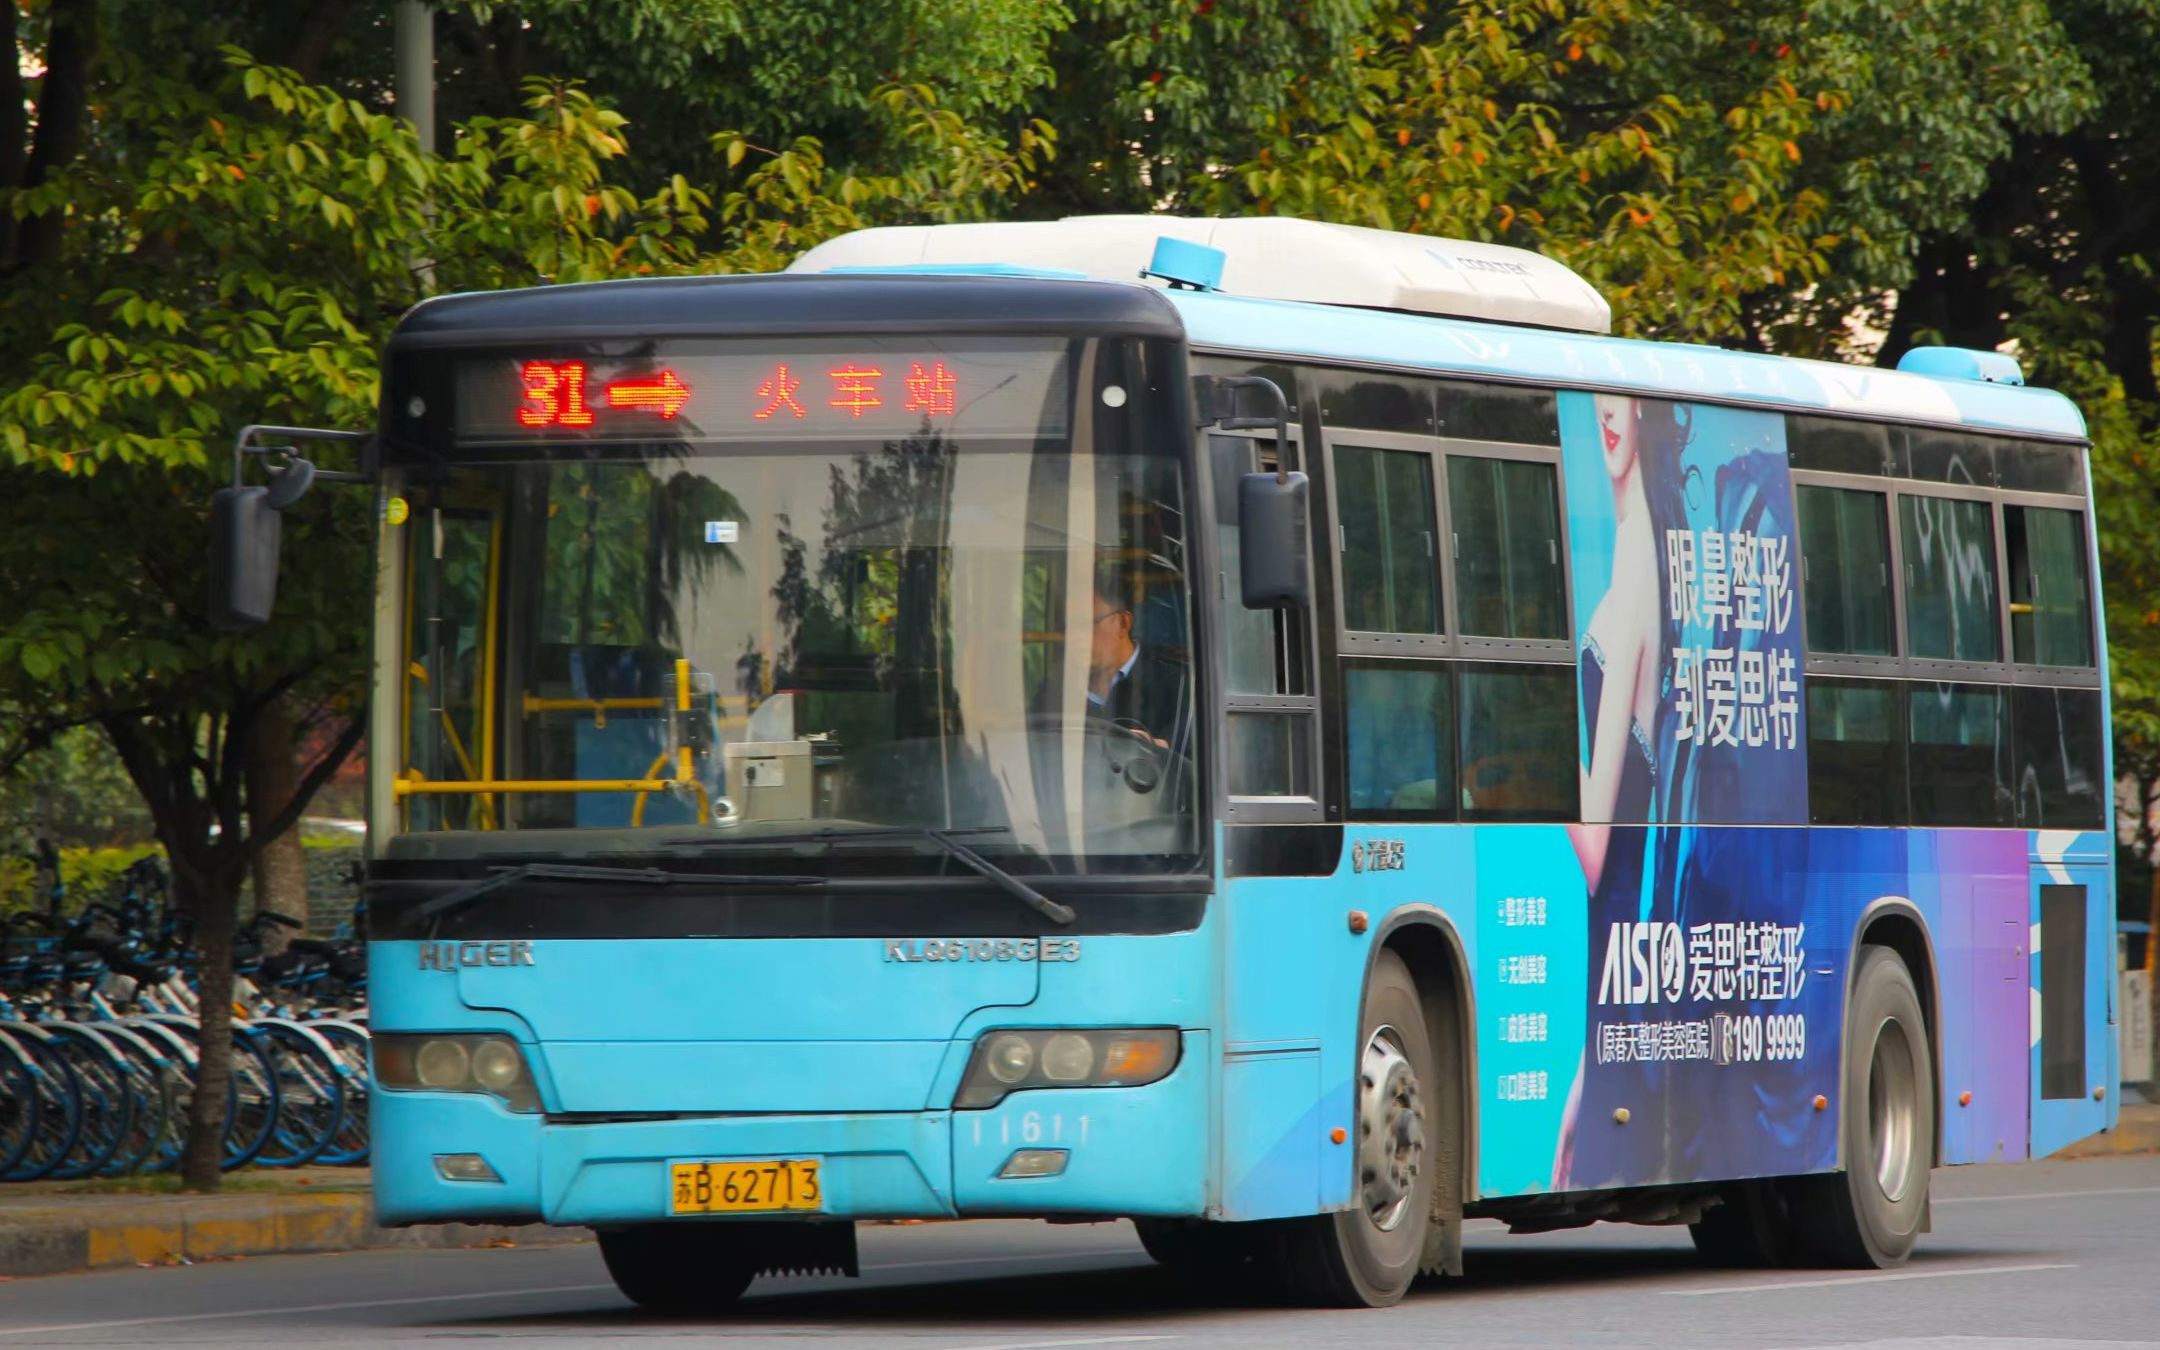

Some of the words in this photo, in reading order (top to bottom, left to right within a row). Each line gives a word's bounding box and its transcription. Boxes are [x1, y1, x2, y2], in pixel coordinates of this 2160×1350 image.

[519, 362, 595, 426] 31
[755, 361, 958, 419] 火车站
[1666, 527, 1793, 635] 眼鼻整形
[1672, 644, 1799, 750] 到爱思特
[418, 940, 536, 973] HIGER
[1689, 921, 1806, 1003] 爱思特整形
[1766, 1013, 1806, 1061] 9999
